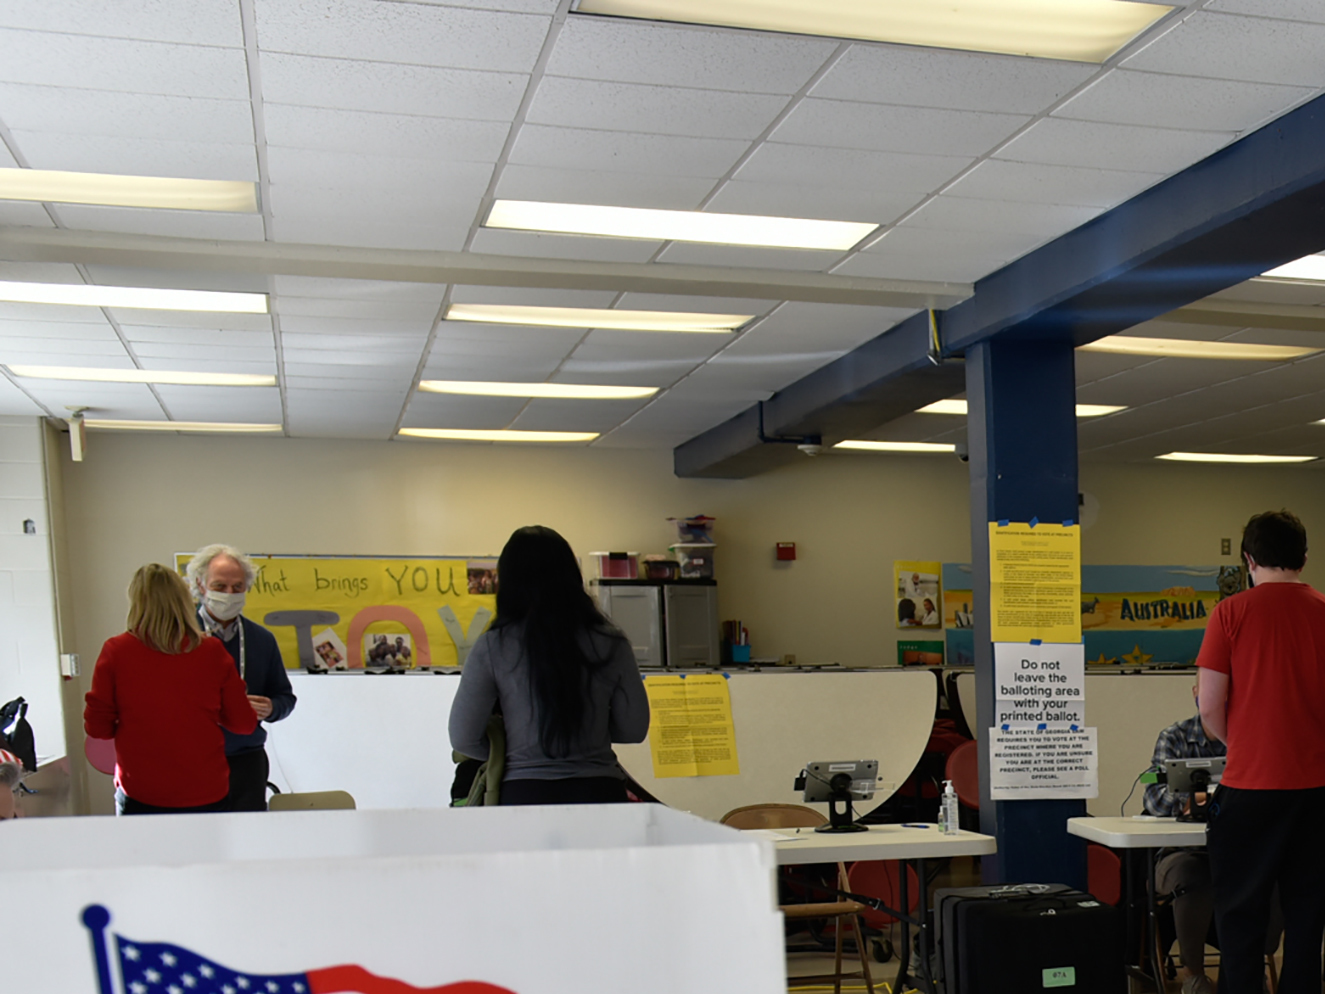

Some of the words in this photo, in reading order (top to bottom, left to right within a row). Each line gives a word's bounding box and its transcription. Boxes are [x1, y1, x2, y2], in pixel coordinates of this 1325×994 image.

[314, 568, 368, 597] brings
[385, 565, 461, 597] YOU
[1120, 598, 1207, 621] AUSTRALIA
[1021, 659, 1038, 670] Do
[1041, 661, 1060, 670] not
[1014, 672, 1045, 682] leave
[1048, 673, 1067, 682] the
[1001, 685, 1052, 698] balloting
[1055, 688, 1080, 696] area
[1013, 698, 1039, 708] with
[1042, 701, 1068, 711] your
[1000, 711, 1043, 723] printed
[1046, 711, 1080, 721] ballot.
